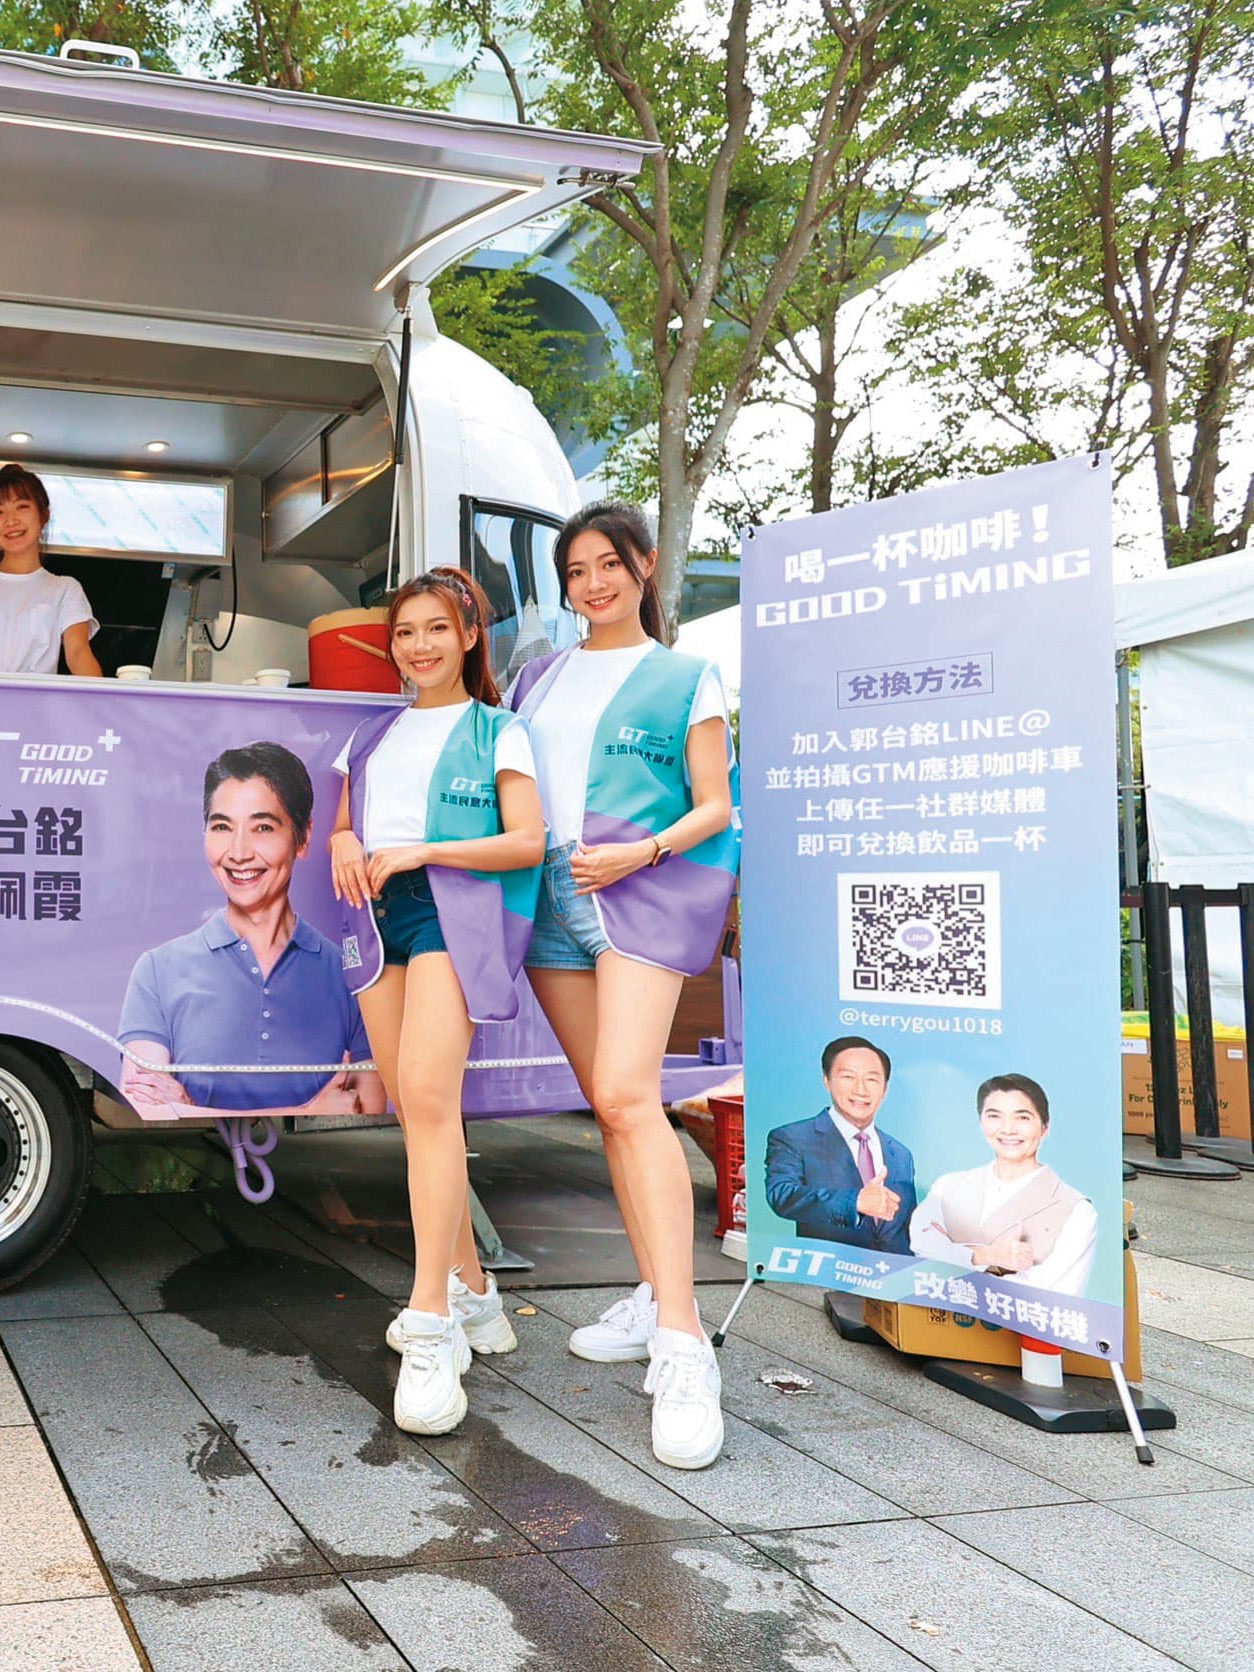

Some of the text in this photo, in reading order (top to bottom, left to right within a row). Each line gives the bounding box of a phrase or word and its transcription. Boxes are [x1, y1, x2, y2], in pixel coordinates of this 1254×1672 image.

[756, 586, 886, 627] GOOD
[617, 726, 649, 744] GT
[792, 709, 1051, 755] 加入郭台銘LINE@
[20, 743, 94, 762] GOOD
[450, 776, 483, 792] GT
[765, 746, 1084, 791] 並拍攝GTM應援咖啡車
[796, 787, 1047, 823] 上傳任一社群媒體
[797, 825, 1048, 857] 即可兌換飲品一杯
[906, 931, 930, 942] LINE
[839, 1007, 1003, 1036] @terrygou1018
[767, 1246, 836, 1277] GT
[835, 1260, 874, 1277] GOOD
[913, 1271, 1089, 1345] 改變 好時機
